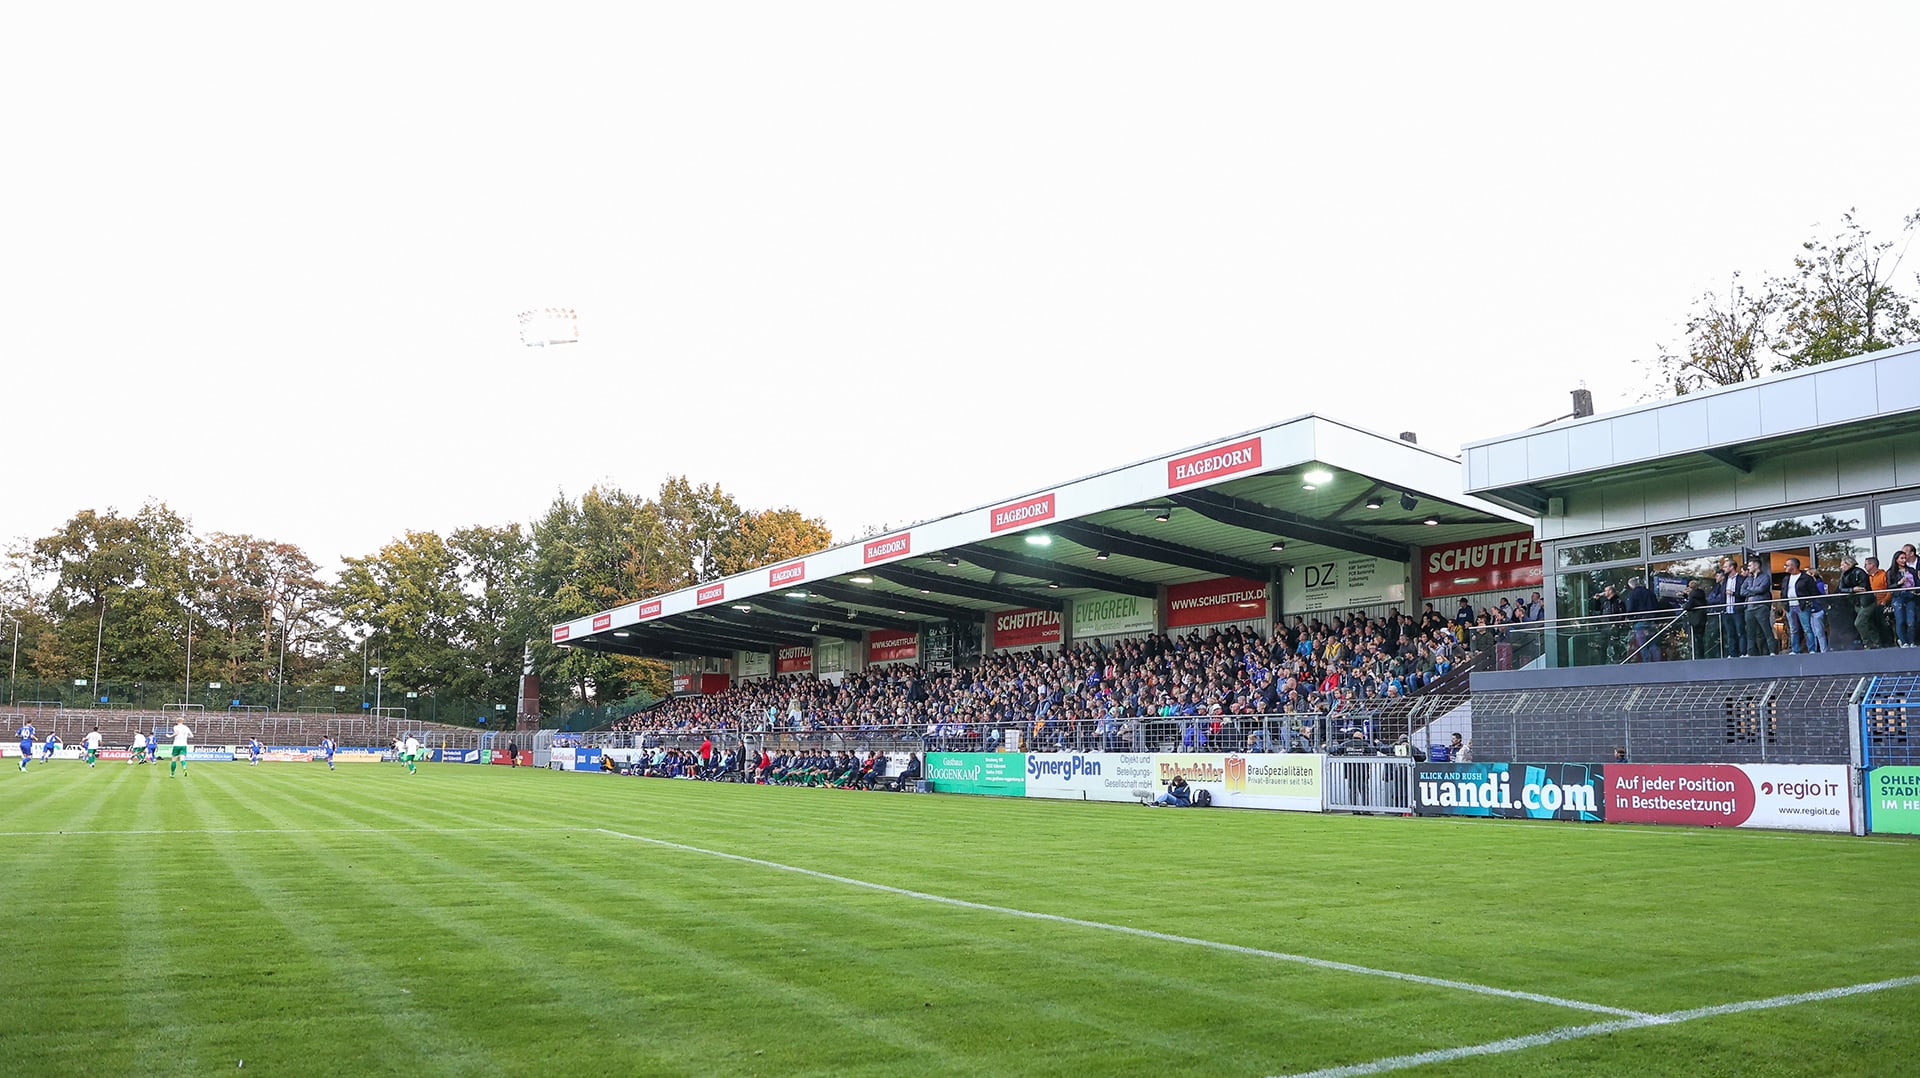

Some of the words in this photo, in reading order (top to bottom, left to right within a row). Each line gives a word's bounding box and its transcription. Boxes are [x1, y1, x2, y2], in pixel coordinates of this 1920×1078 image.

[1176, 447, 1252, 480] HAGEDORN
[996, 501, 1049, 526] HAGEDORN
[867, 538, 907, 558] HAGEDORN
[1305, 563, 1335, 588] DZ
[1075, 596, 1140, 624] EVERGREEN.
[997, 610, 1060, 632] SCHÜTTFLIX
[1027, 755, 1101, 781] SynergPlan
[1120, 754, 1138, 765] Objekt
[1140, 756, 1150, 764] und
[928, 764, 981, 781] ROGGENKAMP
[1117, 766, 1152, 778] Beteiligungs-
[1248, 764, 1314, 777] BrauSpezialitäten
[1420, 772, 1442, 780] KLICK
[1444, 772, 1461, 780] AND
[1104, 779, 1137, 789] Gesellschaft
[1138, 779, 1153, 789] mbH
[1419, 771, 1597, 812] uandi.com
[1616, 776, 1639, 789] Auf
[1641, 776, 1676, 793] jeder
[1679, 777, 1735, 792] Position
[1777, 779, 1821, 799] regio
[1881, 786, 1920, 796] STADI
[1616, 795, 1628, 808] in
[1632, 795, 1736, 815] Bestbesetzung!
[1778, 806, 1841, 817] www.regioit.de
[1881, 799, 1898, 809] IM
